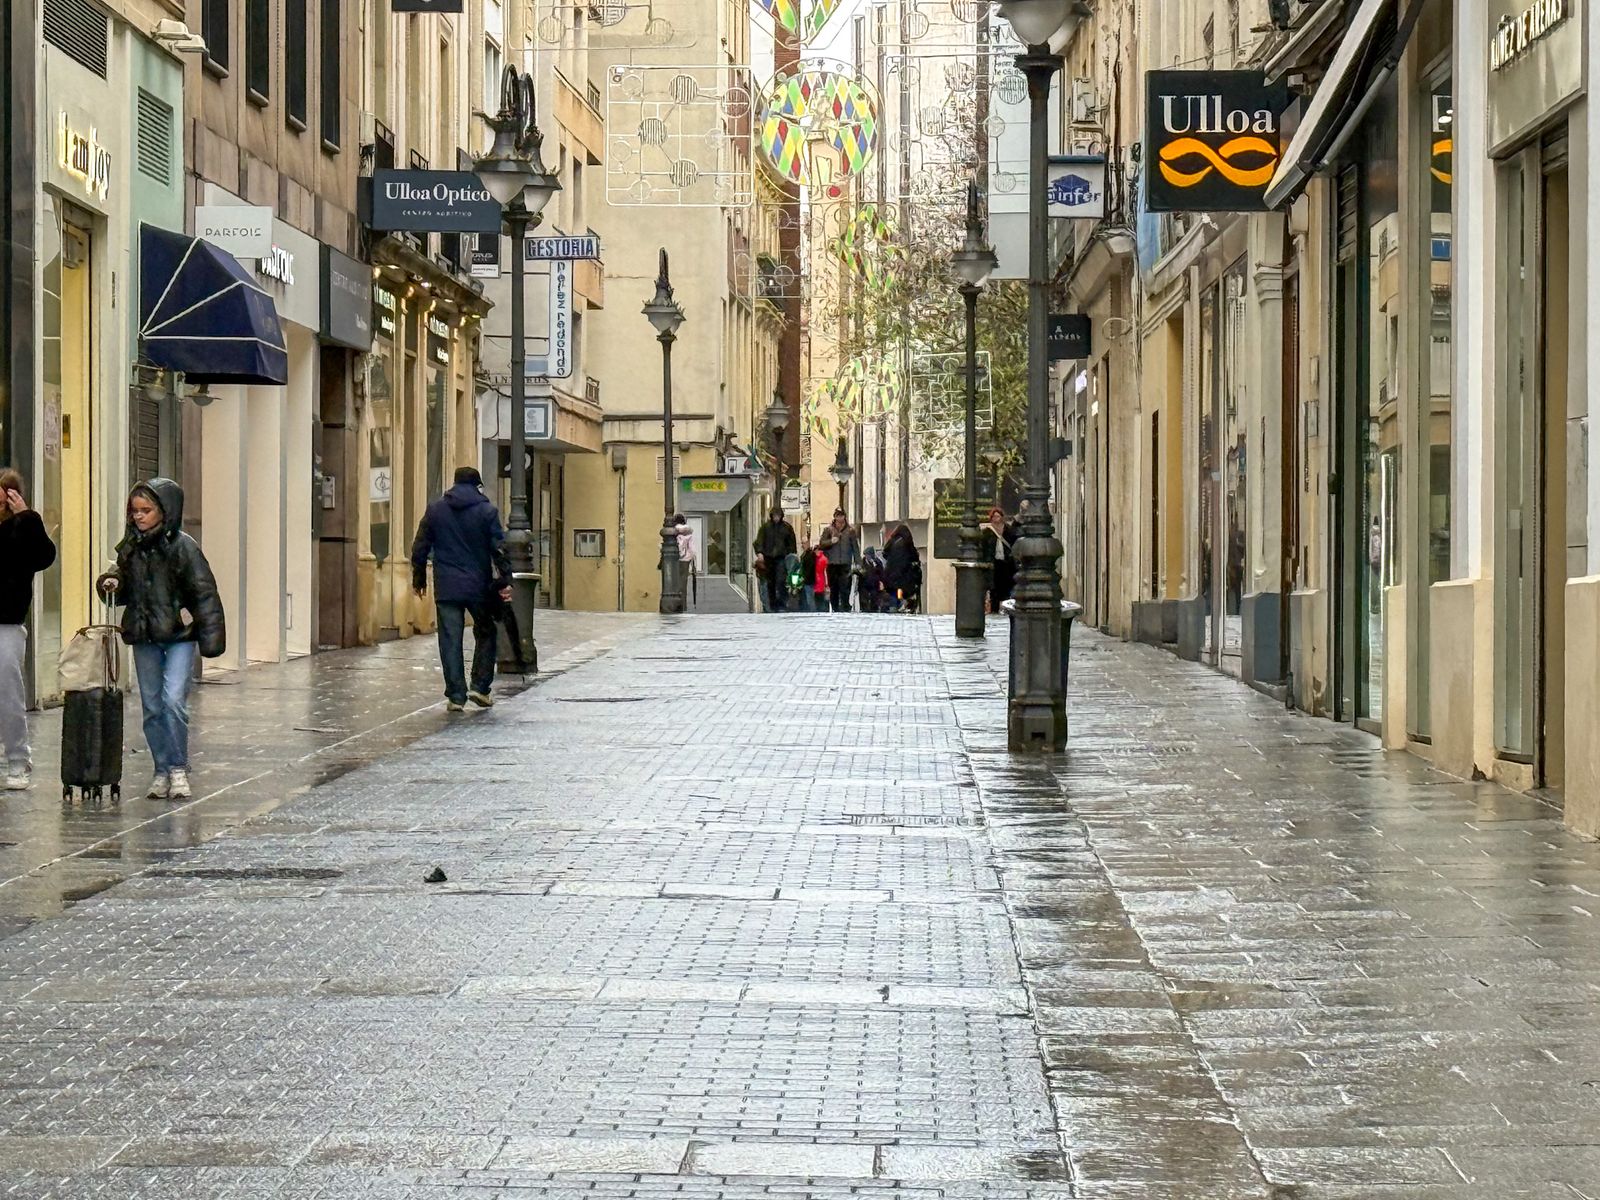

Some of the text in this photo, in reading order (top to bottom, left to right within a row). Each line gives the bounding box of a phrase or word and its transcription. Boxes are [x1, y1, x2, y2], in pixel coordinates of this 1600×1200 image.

[1516, 9, 1531, 53] DE
[1158, 95, 1277, 134] Ulloa
[385, 182, 491, 207] Ulloa Optico
[528, 238, 594, 257] GESTORIA
